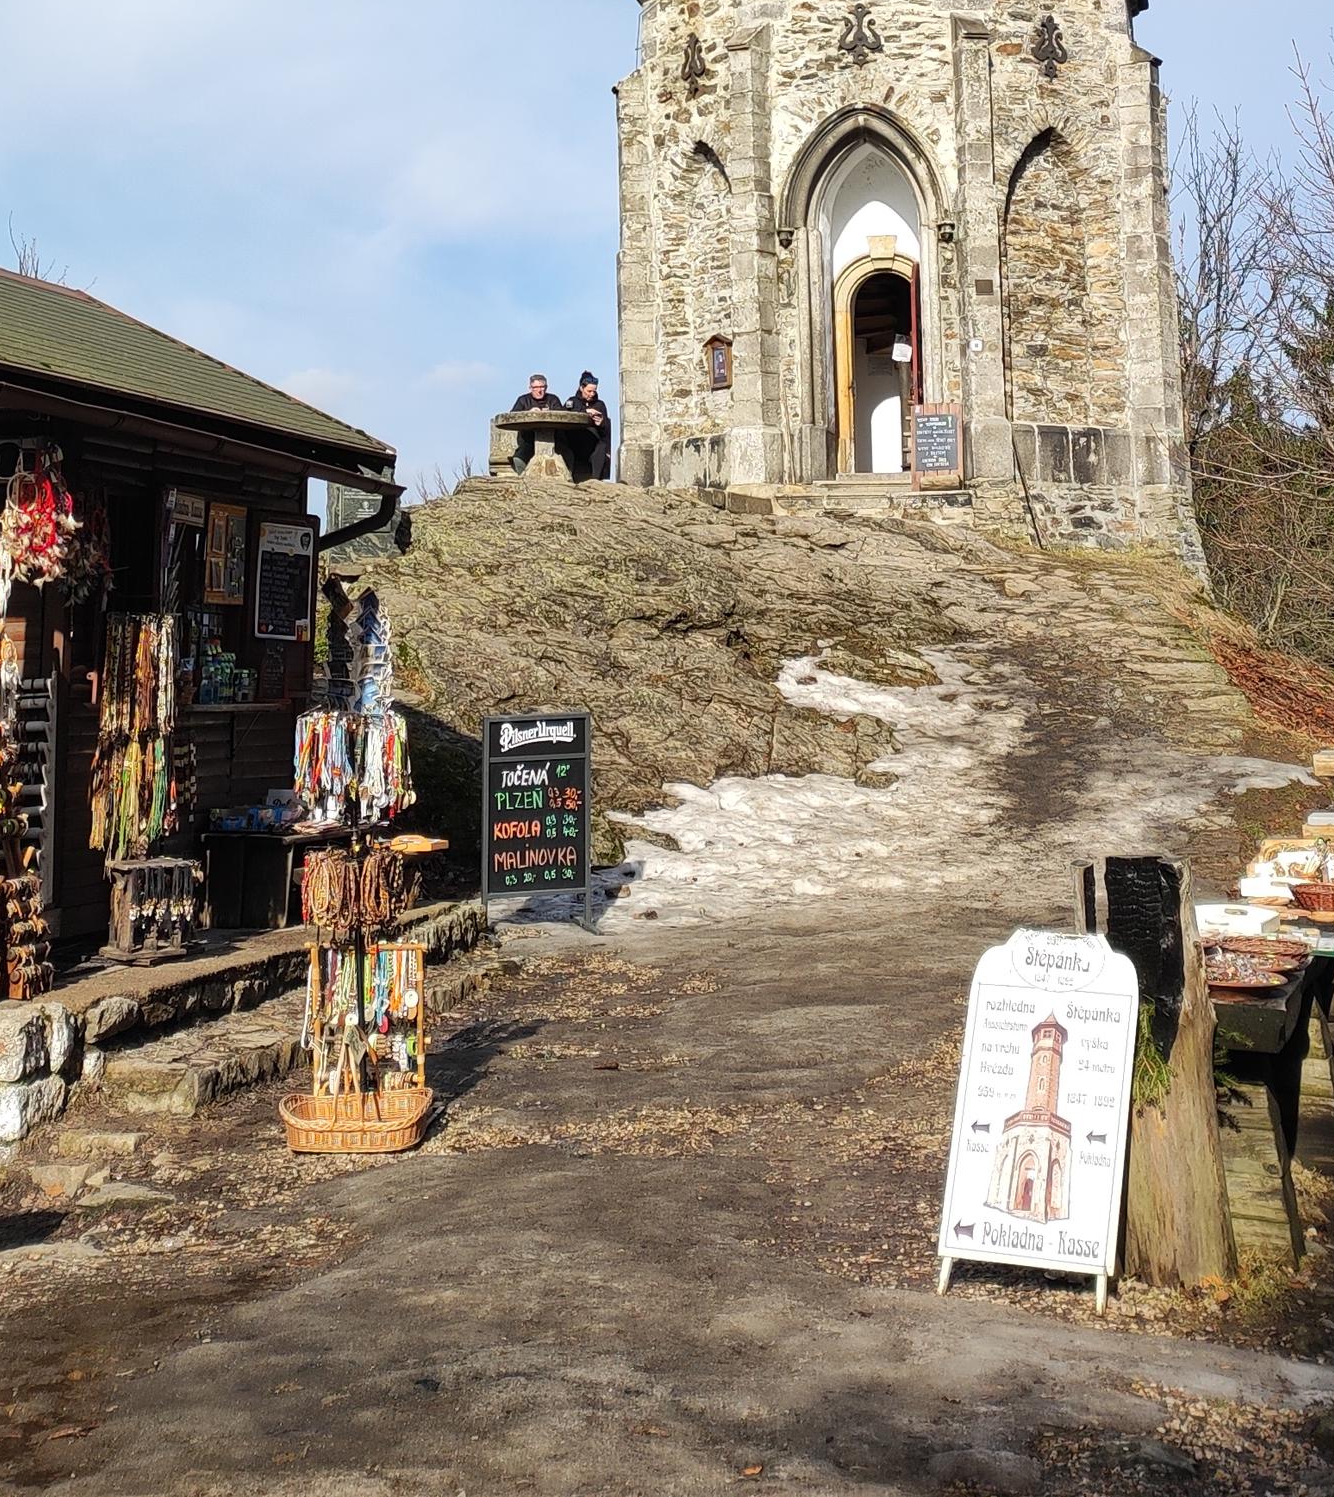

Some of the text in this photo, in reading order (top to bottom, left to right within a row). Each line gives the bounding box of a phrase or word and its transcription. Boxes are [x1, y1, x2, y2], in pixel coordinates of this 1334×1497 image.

[499, 721, 576, 753] Pilsner Urquell
[501, 761, 551, 789] TOČENÁ
[494, 787, 544, 811] PLZEŇ
[493, 819, 541, 841] KOFOLA
[981, 1221, 1044, 1252] Pokladna
[1057, 1230, 1100, 1259] Kasse
